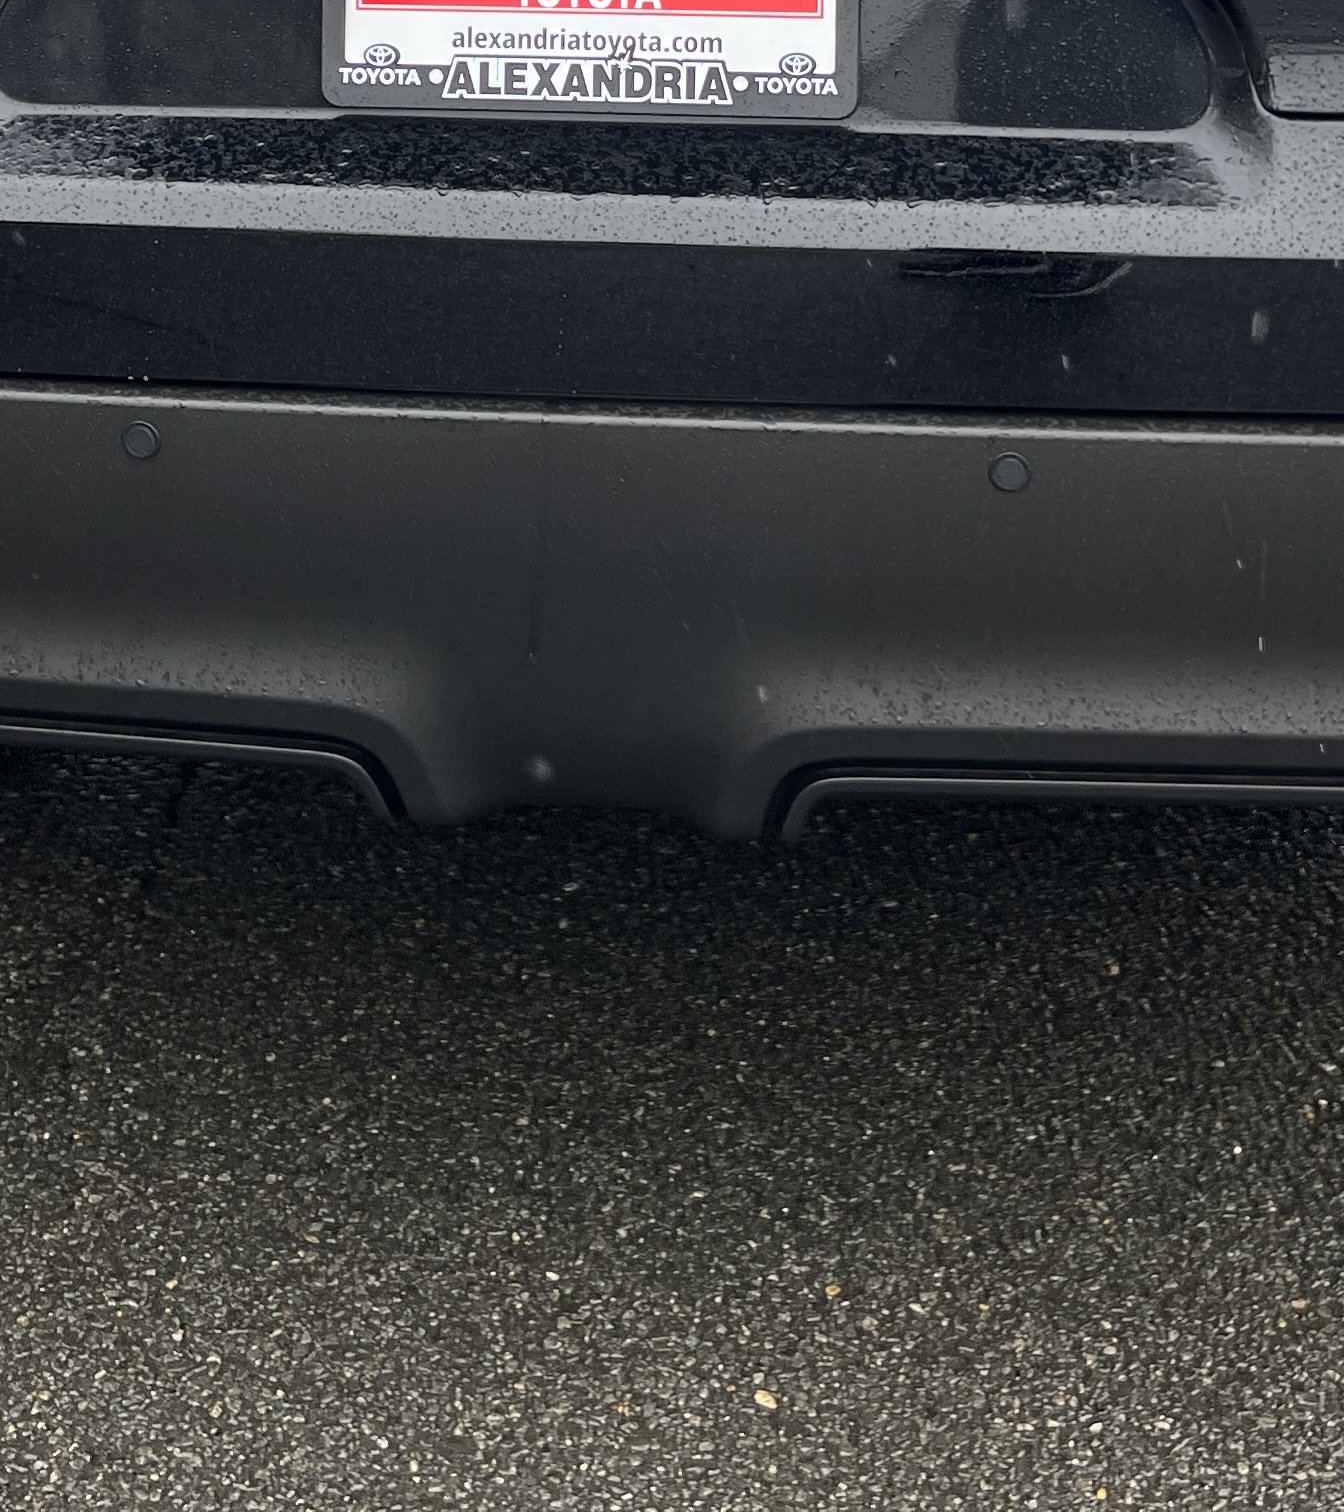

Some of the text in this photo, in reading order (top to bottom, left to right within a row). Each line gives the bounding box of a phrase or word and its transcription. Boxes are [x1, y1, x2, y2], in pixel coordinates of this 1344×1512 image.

[451, 25, 723, 57] alexandriatoyota.com
[338, 67, 422, 87] TOYOTA
[443, 55, 733, 105] ALEXANDRIA
[754, 76, 839, 96] TOYOTA
